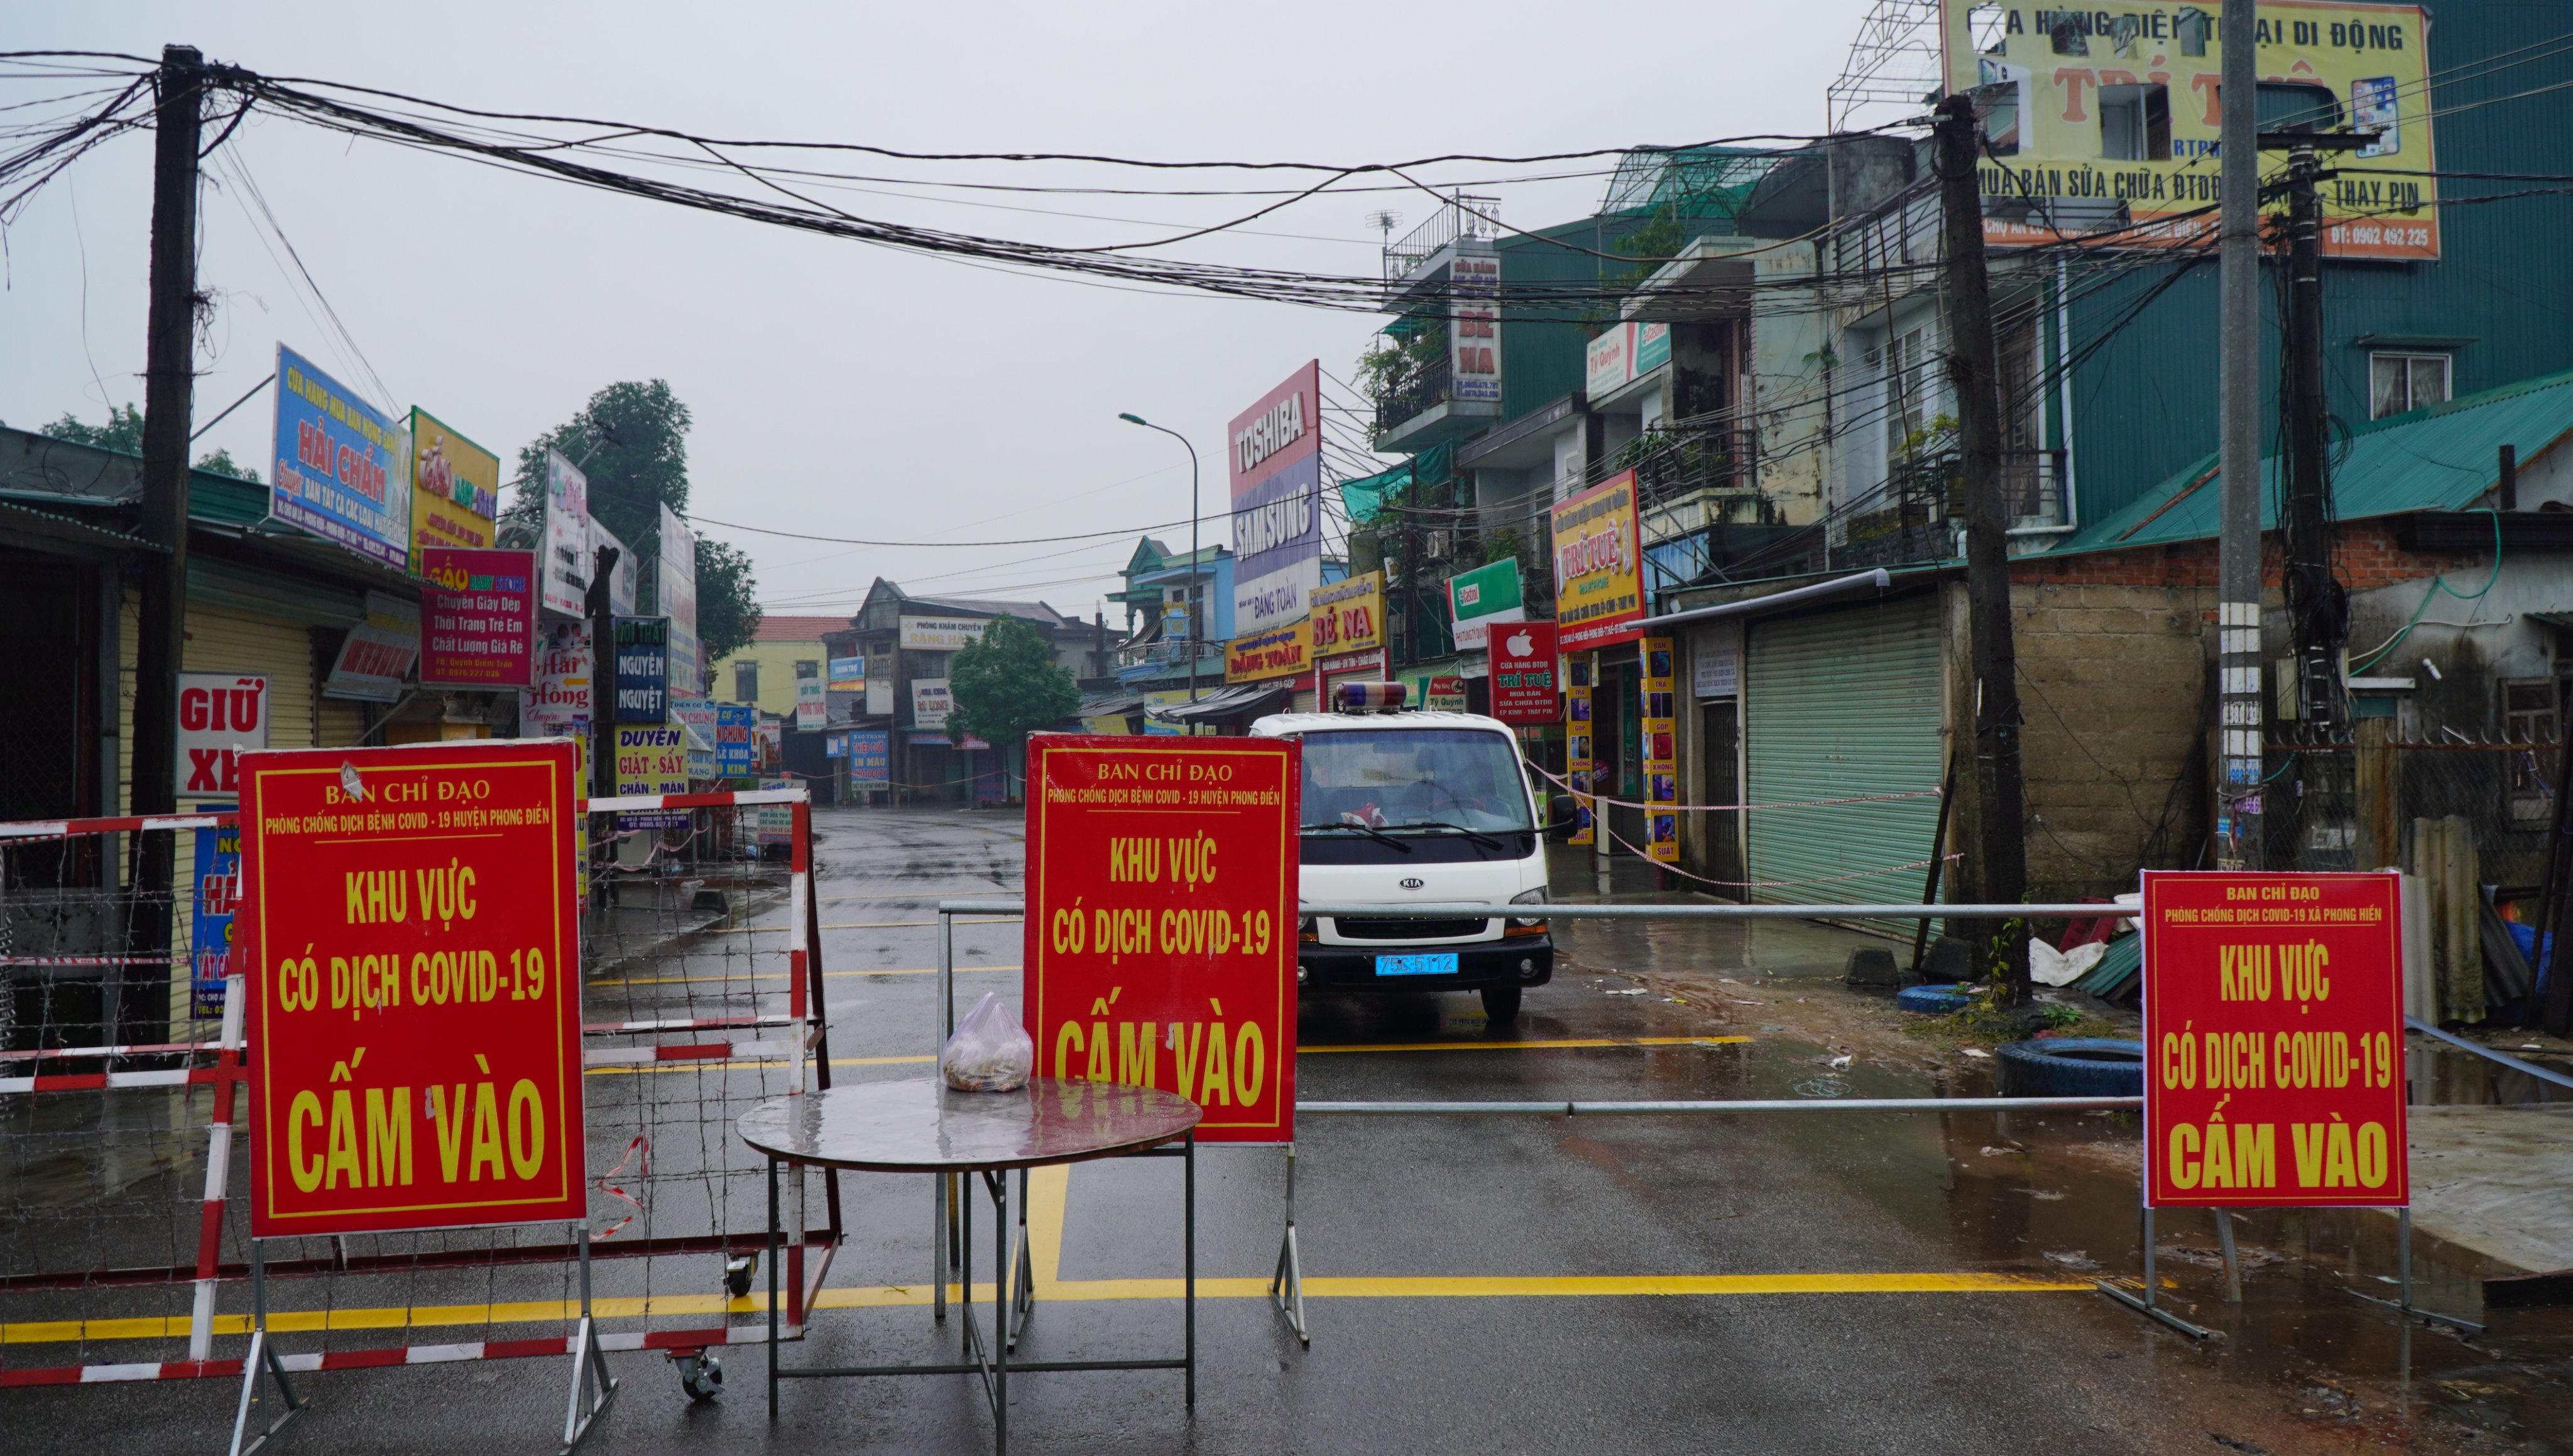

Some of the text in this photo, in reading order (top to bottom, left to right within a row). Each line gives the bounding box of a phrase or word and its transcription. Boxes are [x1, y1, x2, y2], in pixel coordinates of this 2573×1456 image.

[2294, 19, 2403, 54] DI ĐỘNG
[2021, 164, 2061, 196] BÁN
[2068, 163, 2107, 197] SỬA
[2115, 168, 2165, 200] CHỮA
[2333, 180, 2381, 207] THAY
[2390, 182, 2419, 208] PIN
[2352, 227, 2380, 244] 0902
[2383, 228, 2405, 245] 492
[2408, 229, 2428, 246] 225
[1459, 347, 1495, 374] NA
[298, 415, 333, 477] HẢI
[1235, 391, 1306, 474] TOSHIBA
[1236, 482, 1311, 562] SAMSUNG
[1563, 518, 1620, 580] TRÍ TUỆ
[470, 575, 494, 591] BABY
[496, 576, 525, 592] STORE
[1255, 587, 1275, 619] ĐĂNG
[1276, 577, 1297, 611] TOÀN
[1463, 587, 1479, 604] Castrol
[437, 594, 520, 612] Chuyên Giày Dép
[458, 616, 486, 633] Trang
[489, 616, 504, 633] Trẻ
[507, 618, 522, 633] Em
[1313, 606, 1338, 646] BÉ
[1342, 606, 1374, 641] NA
[432, 635, 523, 656] Chất Lượng Giá Rẻ
[619, 651, 664, 679] NGUYÊN
[1498, 670, 1553, 690] TRÍ TUỆ
[179, 678, 265, 732] GIỮ
[619, 686, 663, 715] NGUYỆT
[620, 724, 682, 747] DUYÊN
[618, 747, 684, 780] GIẶT SẤY
[729, 746, 748, 759] KHÓA
[855, 757, 864, 767] IN
[1653, 761, 1674, 771] KHÔNG
[727, 764, 747, 774] KIM
[852, 768, 887, 778] PHOTOCOPY
[1098, 758, 1233, 785] BAN CHỈ ĐẠO
[383, 775, 428, 803] CHỈ
[438, 780, 490, 805] ĐẠO
[619, 780, 685, 795] CHĂN MÀN
[1047, 783, 1280, 807] PHÒNG CHỐNG DỊCH BỆNH COVID 19 HUYỆN PHONG ĐIỀN
[266, 800, 550, 835] PHÒNG CHỐNG DỊCH BỆNH COVID 19 HUYỆN PHONG ĐIỀN
[1110, 829, 1217, 893] KHU VỰC
[346, 857, 476, 932] KHU VỰC
[1402, 879, 1424, 888] KIA
[2227, 883, 2320, 904] BAN CHỈ ĐẠO
[2201, 904, 2234, 923] CHỐNG
[2236, 908, 2259, 925] DỊCH
[2262, 908, 2305, 922] COVID-19
[2308, 906, 2322, 921] XÃ
[2324, 908, 2356, 921] PHONG
[1052, 896, 1270, 965] CÓ DỊCH COVID-19
[278, 943, 545, 1021] CÓ DỊCH COVID-19
[2220, 938, 2330, 1014] KHU VỰC
[1054, 987, 1264, 1108] CẤM VÀO
[2162, 1020, 2391, 1102] CÓ DỊCH COVID-19
[288, 1046, 545, 1193] CẤM VÀO
[2168, 1100, 2388, 1190] CẤM VÀO
